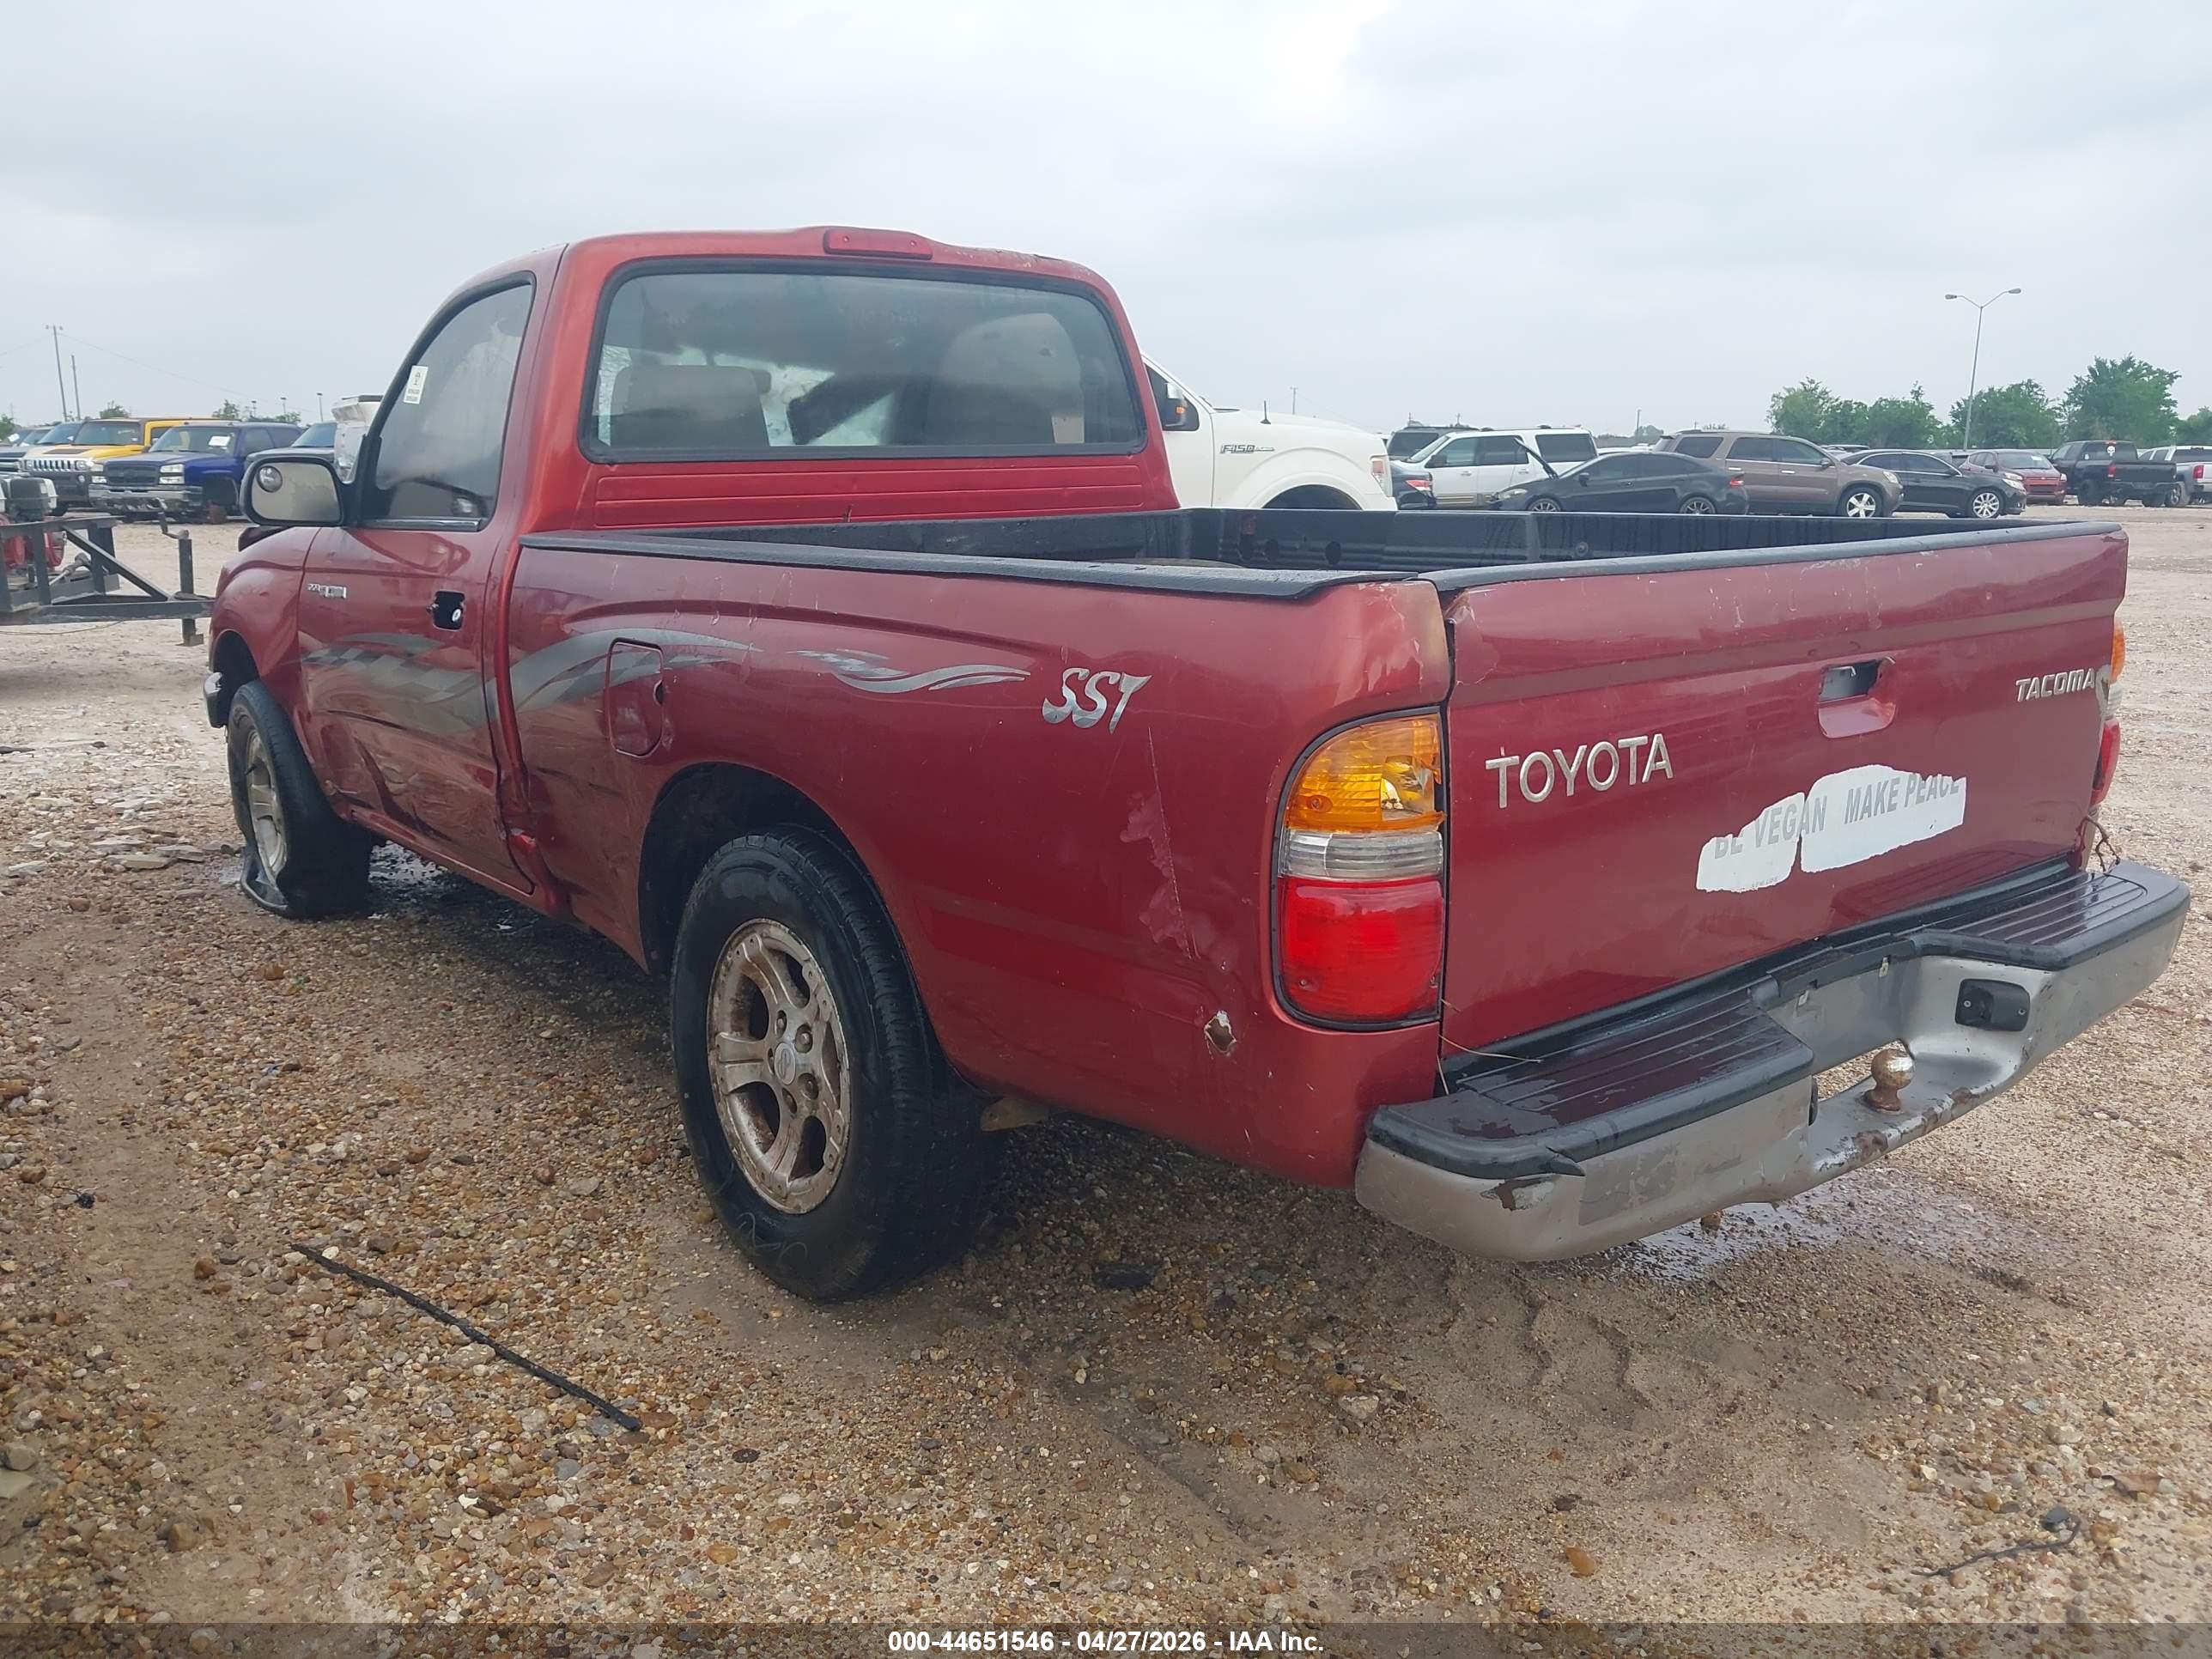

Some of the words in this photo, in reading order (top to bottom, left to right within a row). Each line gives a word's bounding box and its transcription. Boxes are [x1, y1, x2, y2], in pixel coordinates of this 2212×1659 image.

[1042, 667, 1152, 734] SST
[2015, 668, 2095, 702] TACOMA
[1485, 733, 1674, 809] TOYOTA
[1754, 796, 1827, 848] VEGAN
[1844, 777, 1901, 825] MAKE
